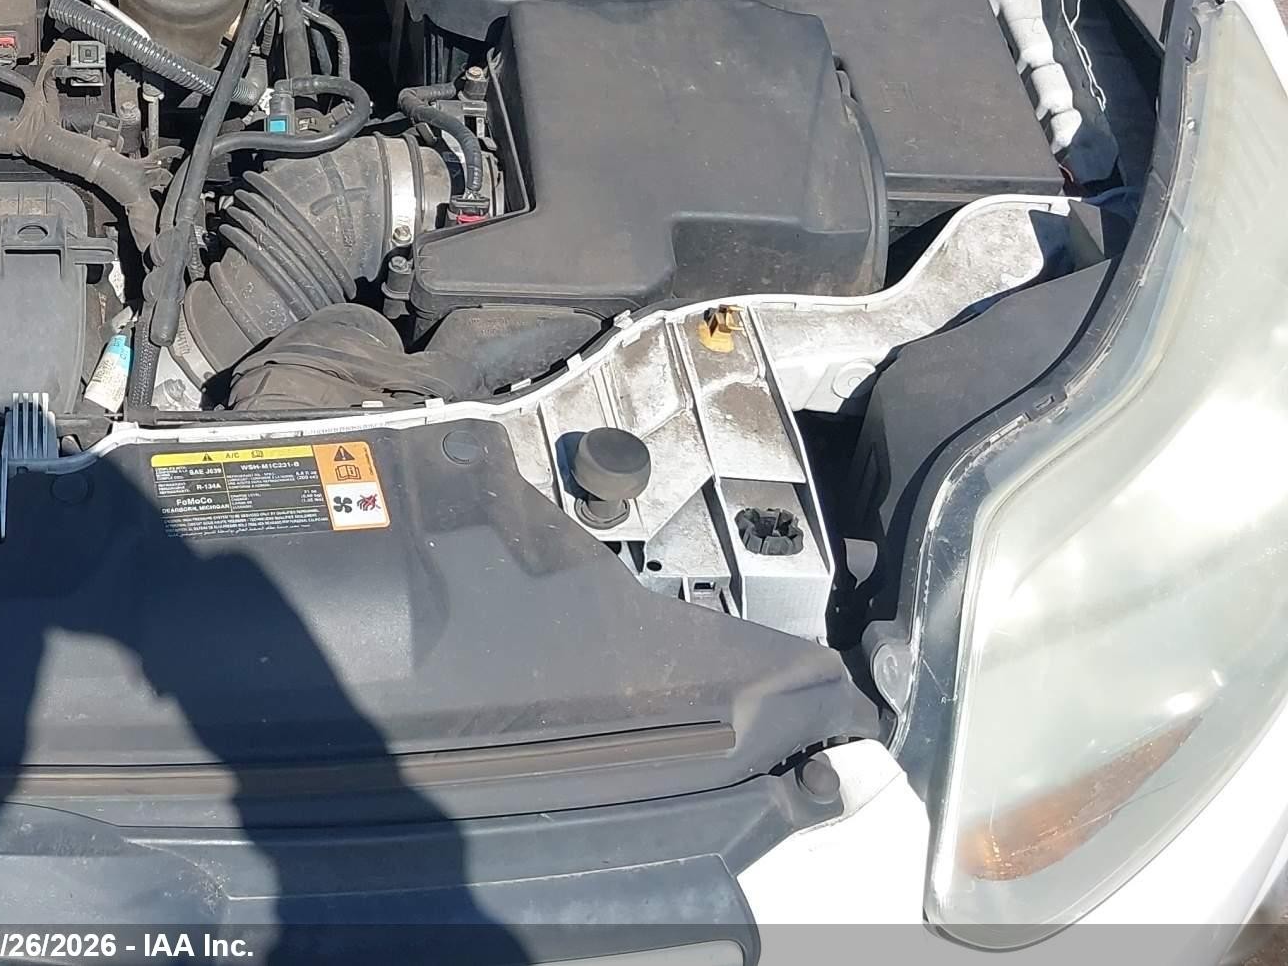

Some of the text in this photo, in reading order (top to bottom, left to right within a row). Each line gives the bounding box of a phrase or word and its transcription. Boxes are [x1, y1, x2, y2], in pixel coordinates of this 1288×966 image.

[205, 467, 222, 475] J639
[196, 483, 222, 491] R-134A
[176, 497, 213, 506] FoMoCo
[199, 504, 230, 512] MICHIGAN
